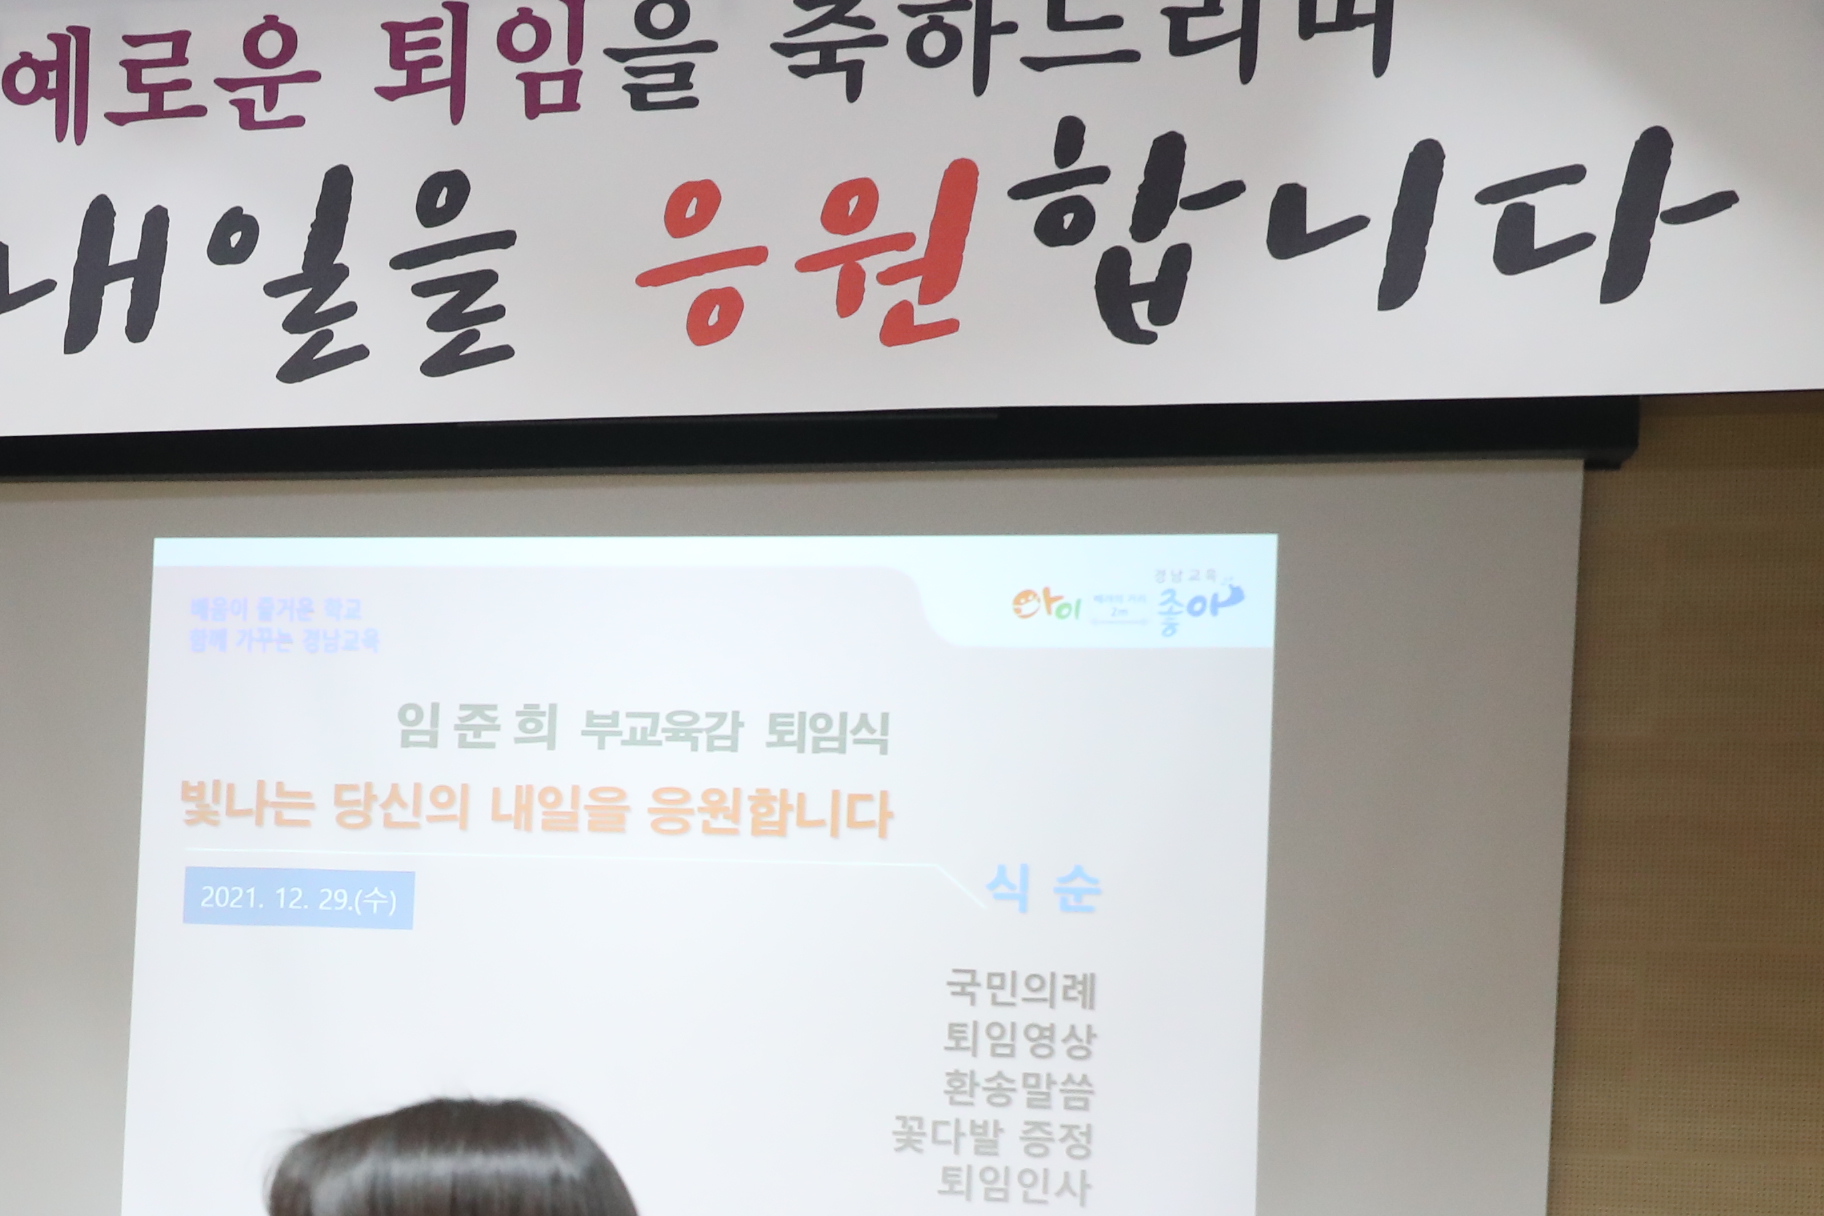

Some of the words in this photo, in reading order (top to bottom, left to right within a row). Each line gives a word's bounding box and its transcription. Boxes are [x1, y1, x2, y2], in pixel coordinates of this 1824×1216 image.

[375, 0, 719, 125] 퇴임을
[635, 115, 1741, 348] 응원합니다
[323, 596, 364, 622] 학교
[302, 627, 382, 655] 경남교육
[580, 709, 745, 753] 부교육감
[765, 711, 890, 755] 퇴임식
[180, 779, 316, 828] 빛나는
[333, 781, 470, 832] 당신의
[491, 784, 630, 833] 내일을
[647, 786, 895, 840] 응원합니다
[200, 885, 264, 910] 2021.
[275, 886, 309, 910] 12.
[318, 886, 398, 917] 29.(수)
[945, 968, 1097, 1011] 국민의례
[943, 1019, 1098, 1062] 퇴임영상
[943, 1068, 1095, 1112] 환송말씀
[892, 1114, 1005, 1157] 꽃다발
[1019, 1120, 1094, 1161] 증정
[936, 1163, 1094, 1208] 퇴임인사
